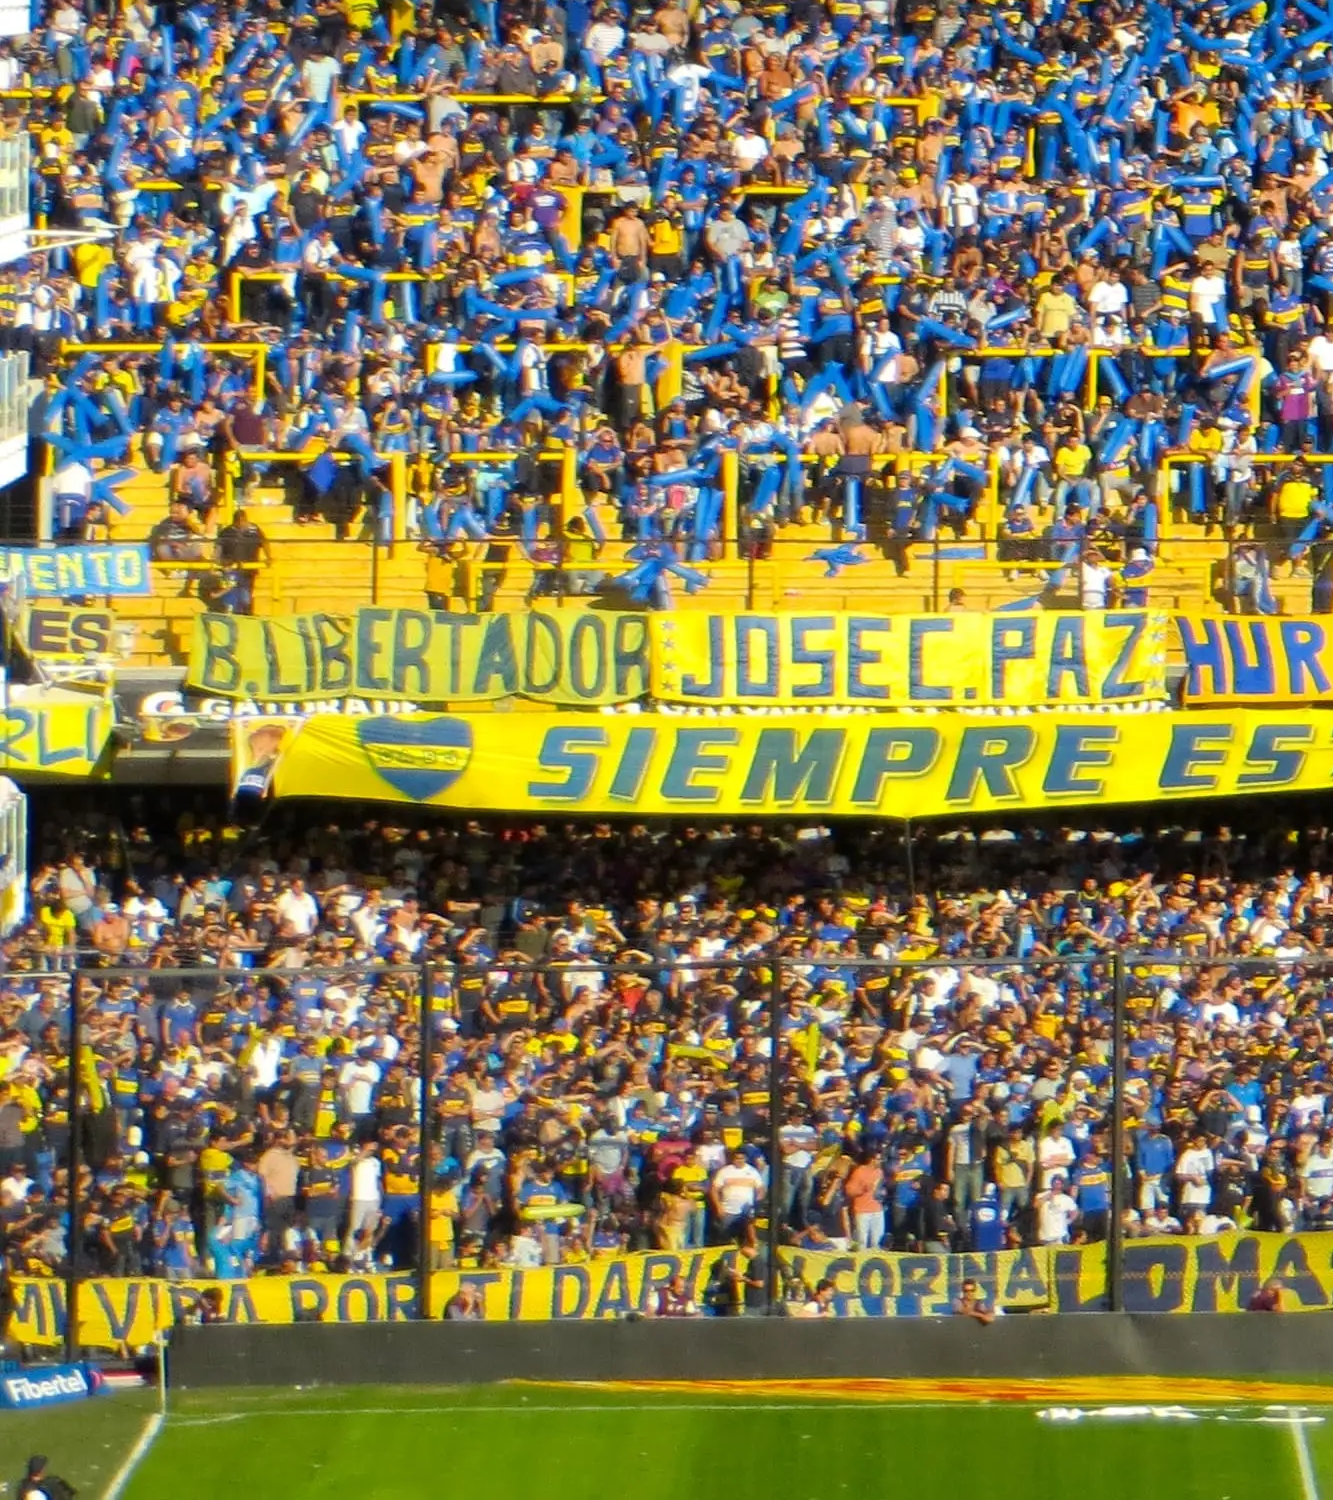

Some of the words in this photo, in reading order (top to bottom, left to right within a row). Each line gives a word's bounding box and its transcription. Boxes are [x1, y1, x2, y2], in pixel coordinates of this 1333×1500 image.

[991, 612, 1149, 699] PAZ
[527, 724, 1121, 807] SIEMPRE
[6, 1369, 88, 1402] Fibertel
